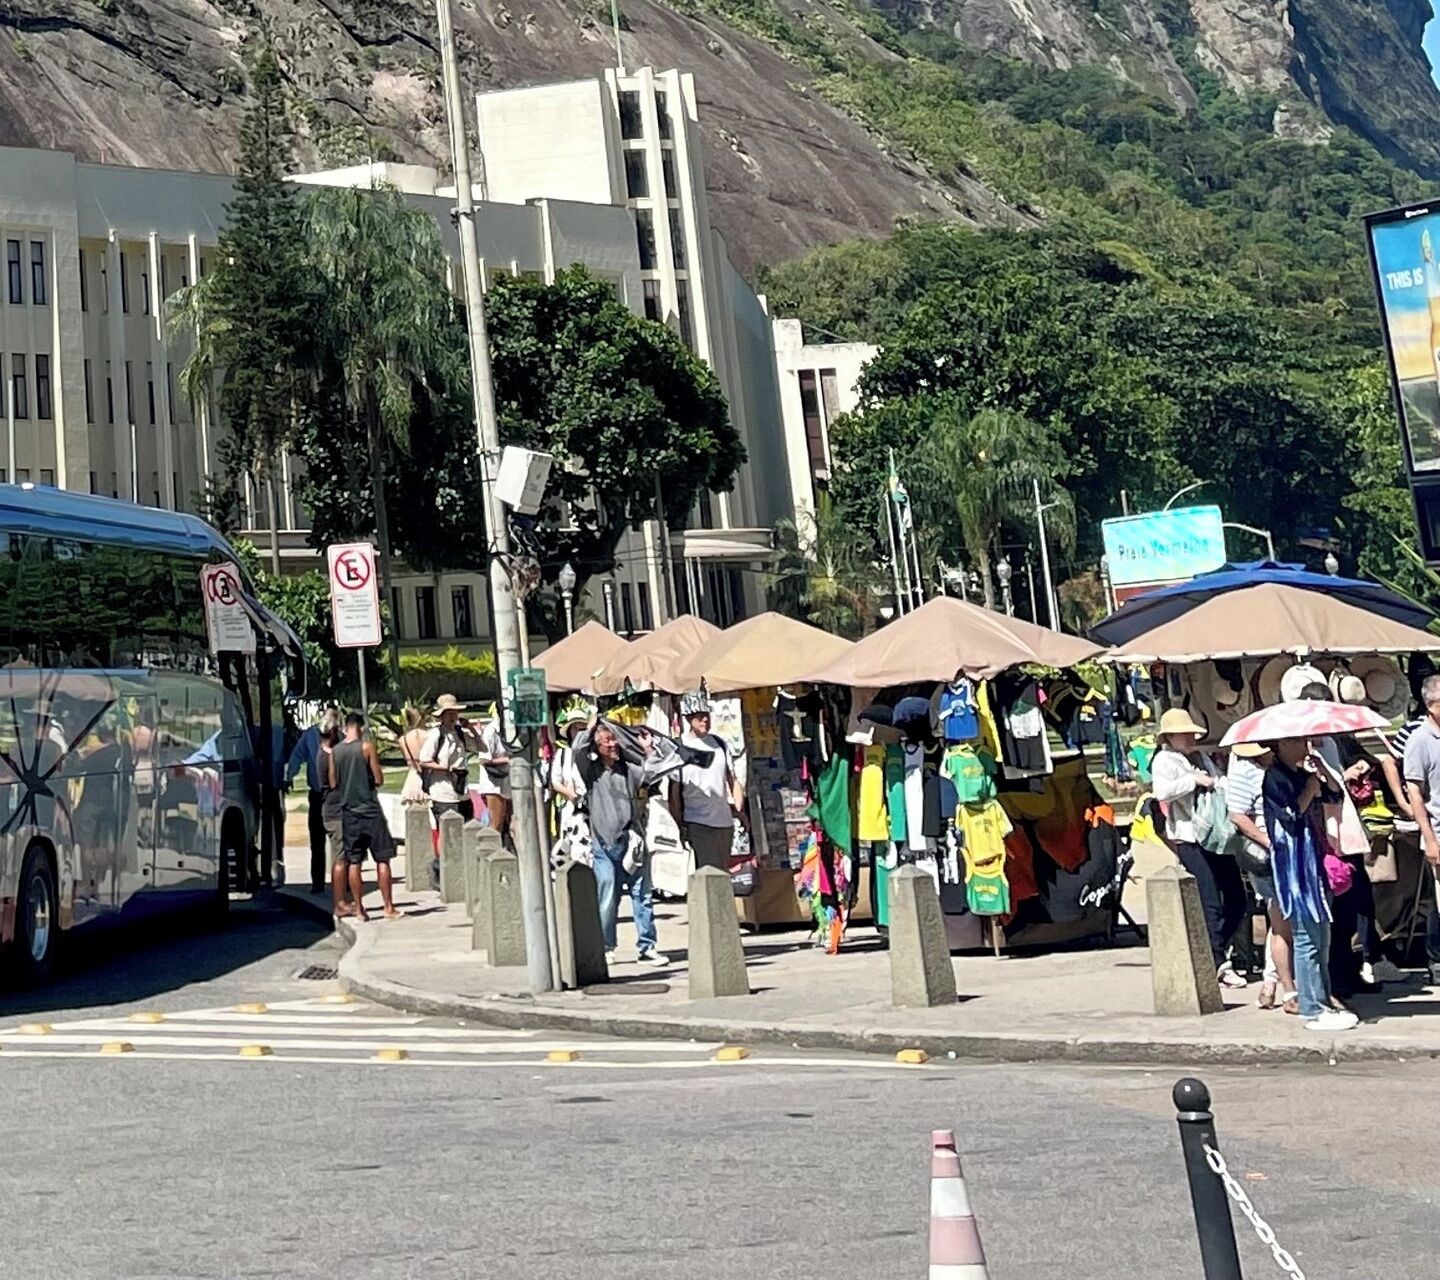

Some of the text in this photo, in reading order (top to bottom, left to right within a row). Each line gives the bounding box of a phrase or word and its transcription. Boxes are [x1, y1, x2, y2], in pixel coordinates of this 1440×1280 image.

[1386, 267, 1424, 290] THIS IS
[1118, 544, 1147, 561] Praia
